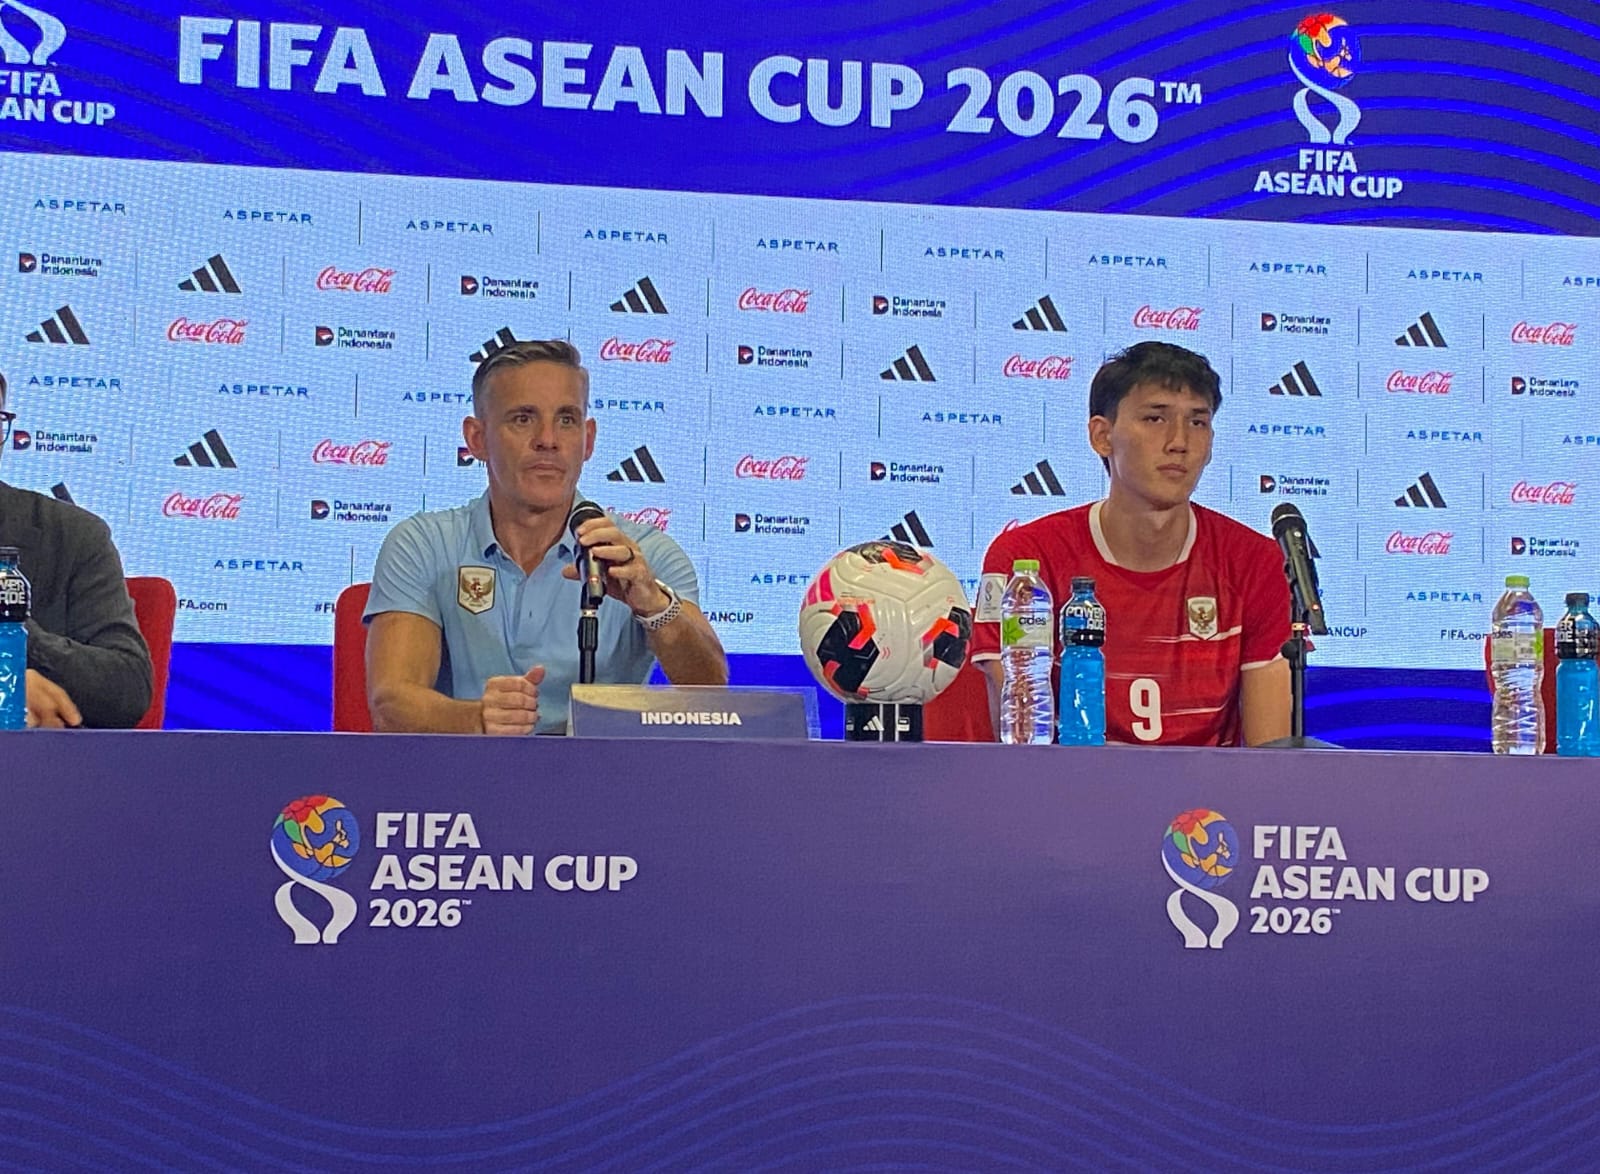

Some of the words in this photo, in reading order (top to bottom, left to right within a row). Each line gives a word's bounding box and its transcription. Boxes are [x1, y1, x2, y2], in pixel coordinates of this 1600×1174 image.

[179, 15, 387, 97] FIFA
[406, 33, 724, 118] ASEAN
[748, 55, 925, 128] CUP
[52, 100, 115, 126] CUP
[1298, 149, 1358, 174] FIFA
[1254, 171, 1345, 197] ASEAN
[1350, 176, 1403, 199] CUP
[35, 200, 126, 215] ASPETAR
[223, 210, 312, 225] ASPETAR
[406, 220, 494, 234] ASPETAR
[584, 229, 668, 243] ASPETAR
[757, 238, 839, 252] ASPETAR
[924, 247, 1005, 259] ASPETAR
[1088, 255, 1167, 268] ASPETAR
[1249, 263, 1327, 275] ASPETAR
[1407, 270, 1483, 282] ASPETAR
[28, 376, 122, 391] ASPETAR
[218, 384, 309, 399] ASPETAR
[588, 400, 665, 412] SPETAR
[754, 405, 836, 418] ASPETAR
[922, 412, 1002, 425] ASPETAR
[1248, 424, 1325, 436] ASPETAR
[1406, 430, 1482, 442] ASPETAR
[213, 559, 303, 571] ASPETAR
[1406, 591, 1483, 603] ASPETAR
[1129, 678, 1163, 741] 9
[640, 711, 742, 727] INDONESIA
[375, 812, 481, 849] FIFA
[1253, 825, 1348, 861] FIFA
[369, 854, 534, 891] ASEAN
[544, 855, 639, 891] CUP
[1250, 865, 1396, 901] ASEAN
[1404, 867, 1490, 902] CUP
